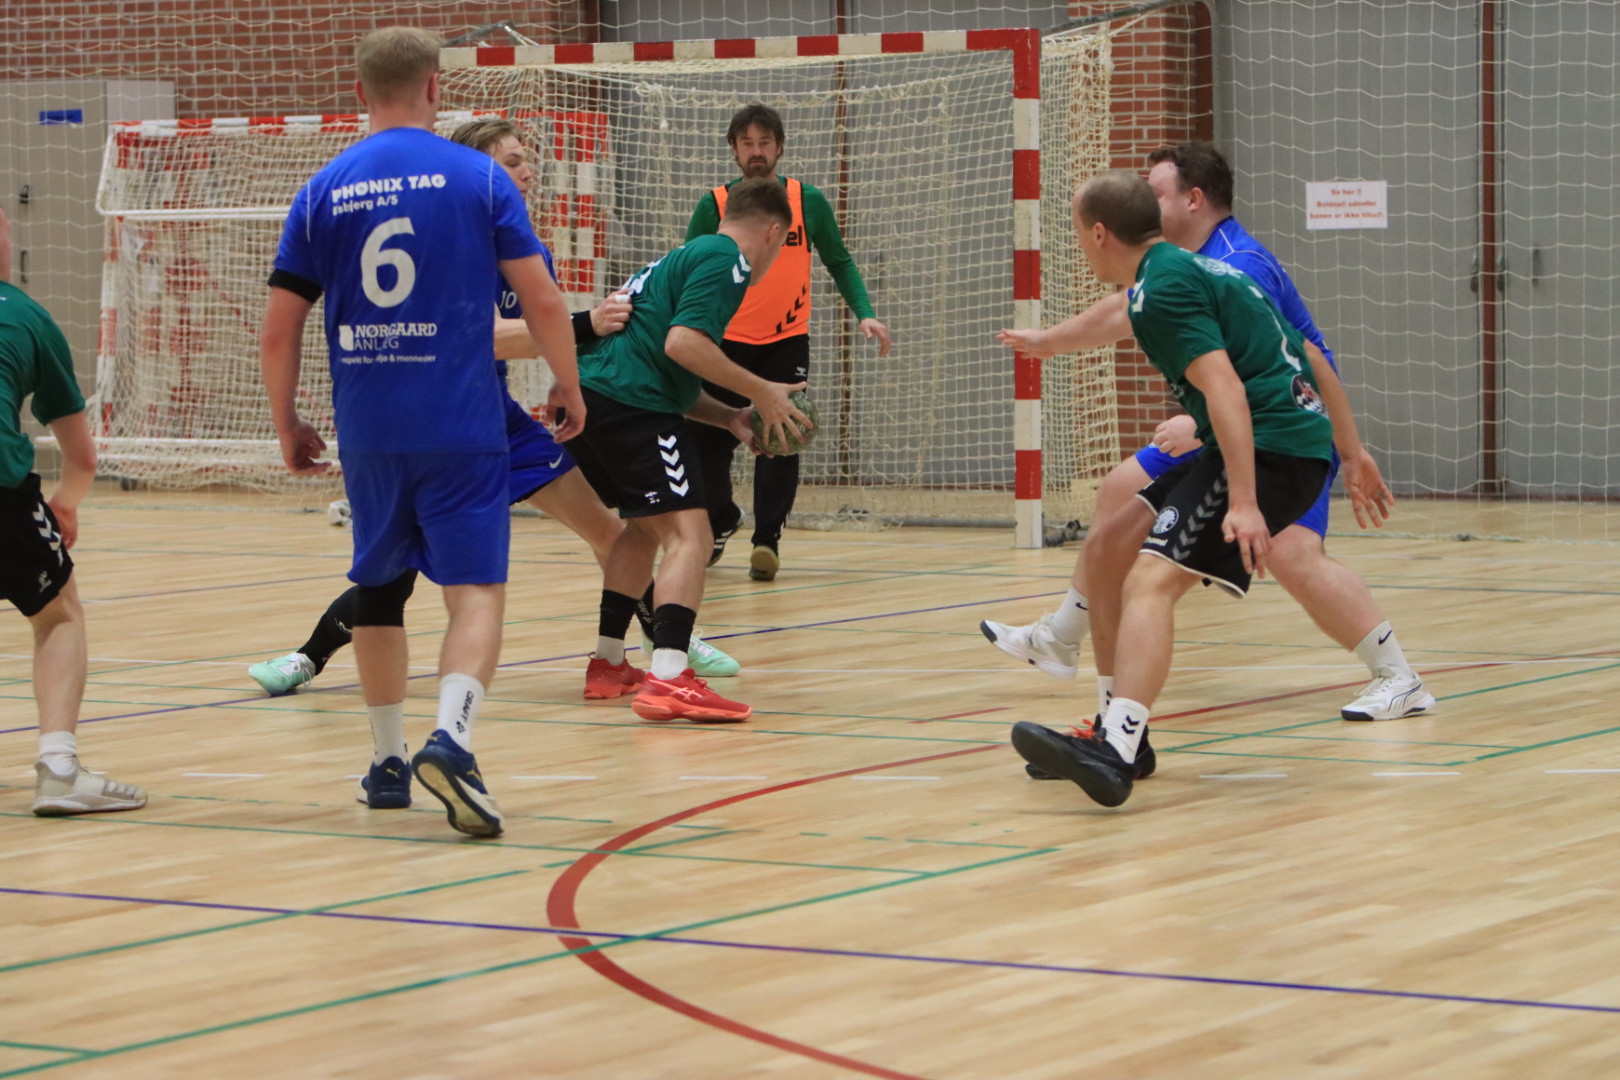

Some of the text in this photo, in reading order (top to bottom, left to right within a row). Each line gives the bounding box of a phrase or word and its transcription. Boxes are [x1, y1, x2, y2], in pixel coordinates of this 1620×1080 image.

[407, 173, 447, 190] TAG
[376, 194, 399, 207] A/S
[360, 217, 416, 308] 6
[354, 322, 438, 338] NØRGAARD
